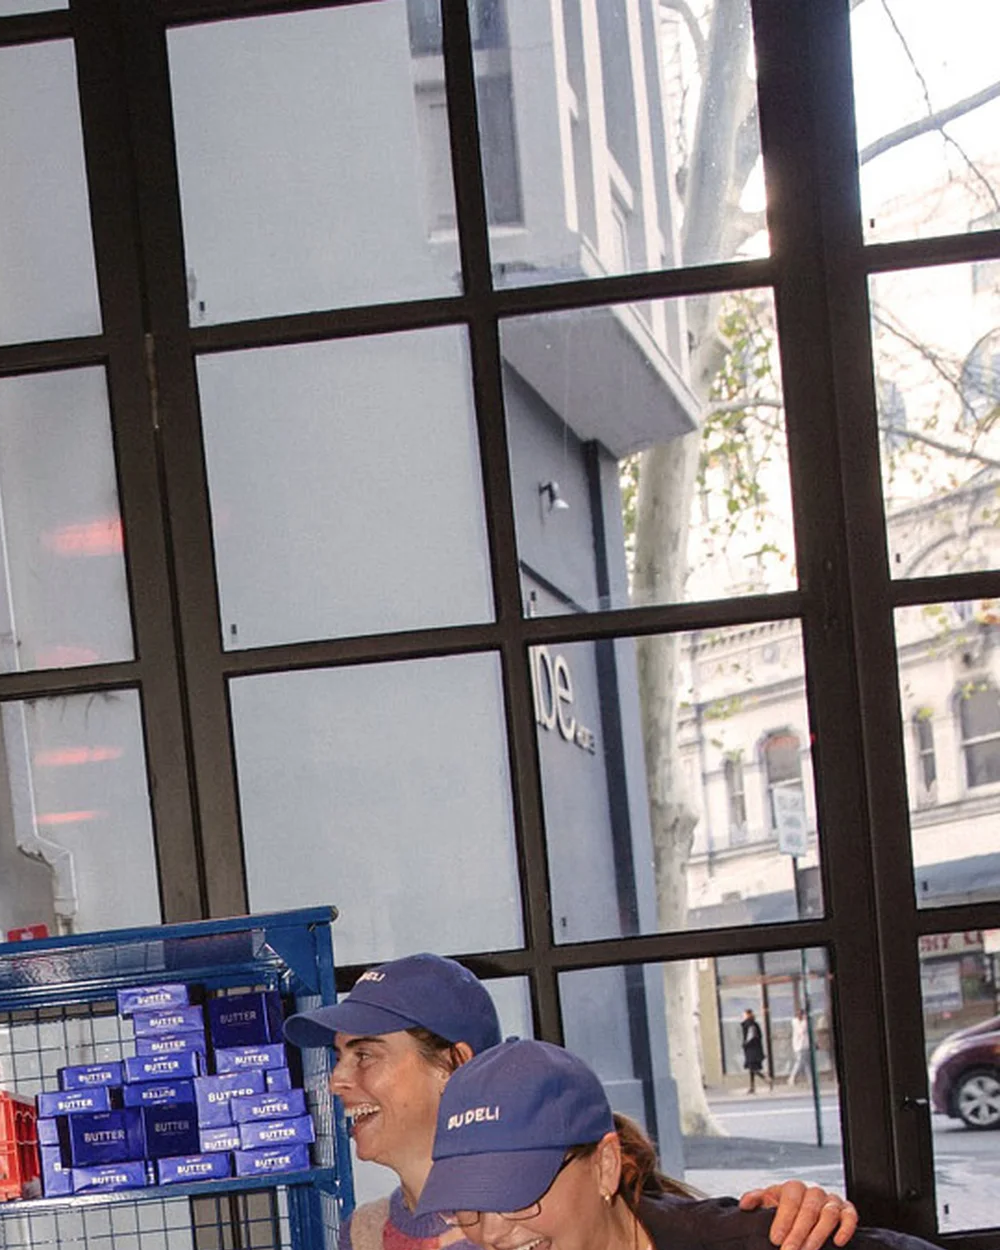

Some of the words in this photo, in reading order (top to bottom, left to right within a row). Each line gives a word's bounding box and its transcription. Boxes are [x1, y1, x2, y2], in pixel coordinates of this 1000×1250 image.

[150, 1016, 184, 1027] BUTTER
[219, 1010, 257, 1023] BUTTER
[151, 1040, 186, 1051] BUTTER
[234, 1053, 270, 1064] BUTTER
[144, 1060, 179, 1072] BUTTER
[78, 1072, 112, 1082] BUTTER
[58, 1099, 93, 1110] BUTTER
[252, 1103, 289, 1114] BUTTER
[465, 1106, 499, 1125] DELI
[155, 1120, 190, 1132] BUTTER
[84, 1129, 125, 1143] BUTTER
[259, 1128, 296, 1139] BUTTER
[205, 1138, 241, 1149] BUTTER
[255, 1156, 291, 1167] BUTTER
[177, 1163, 213, 1173] BUTTER
[92, 1174, 128, 1184] BUTTER
